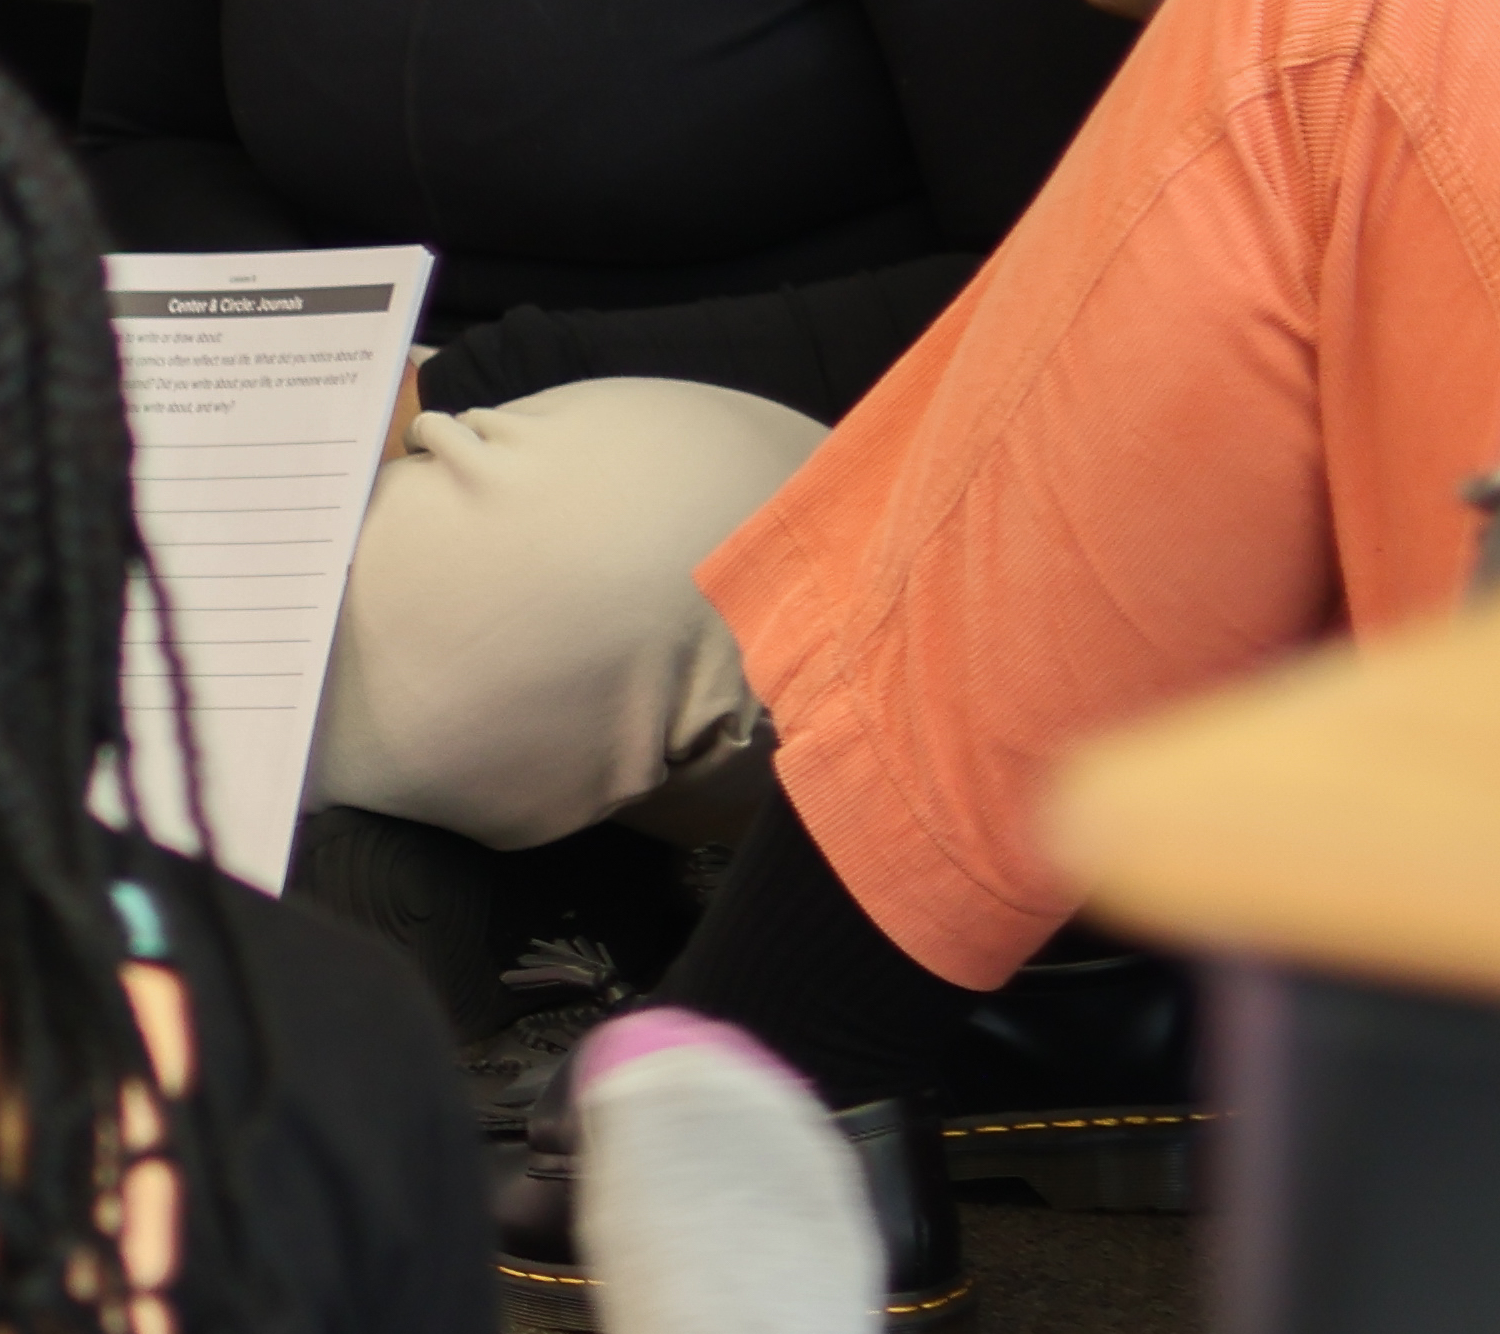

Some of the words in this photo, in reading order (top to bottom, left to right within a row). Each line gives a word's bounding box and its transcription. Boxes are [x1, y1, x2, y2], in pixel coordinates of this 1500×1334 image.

[168, 297, 208, 314] Center
[219, 296, 256, 313] Circle:
[257, 295, 305, 312] Journals
